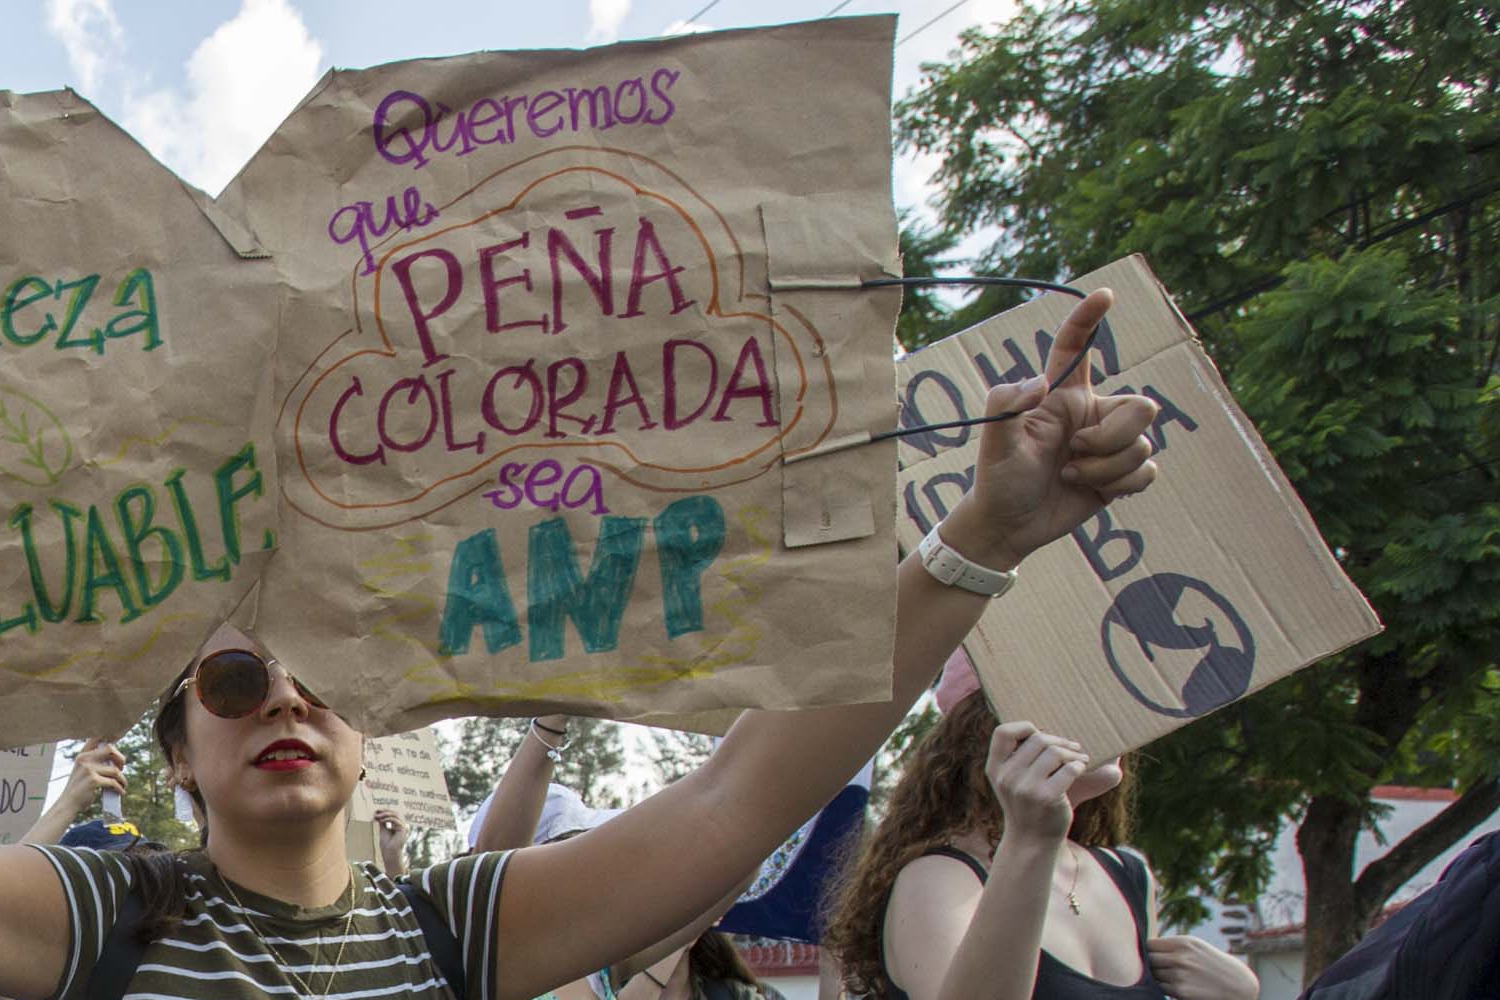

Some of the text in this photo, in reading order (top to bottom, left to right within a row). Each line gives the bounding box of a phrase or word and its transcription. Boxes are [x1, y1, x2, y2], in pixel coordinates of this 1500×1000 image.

[373, 68, 681, 170] Queremos
[328, 186, 438, 277] que
[392, 205, 695, 369] PEÑA
[329, 335, 781, 466] COLORADA
[483, 458, 608, 516] sea
[438, 494, 727, 663] ANP
[1070, 506, 1144, 581] B
